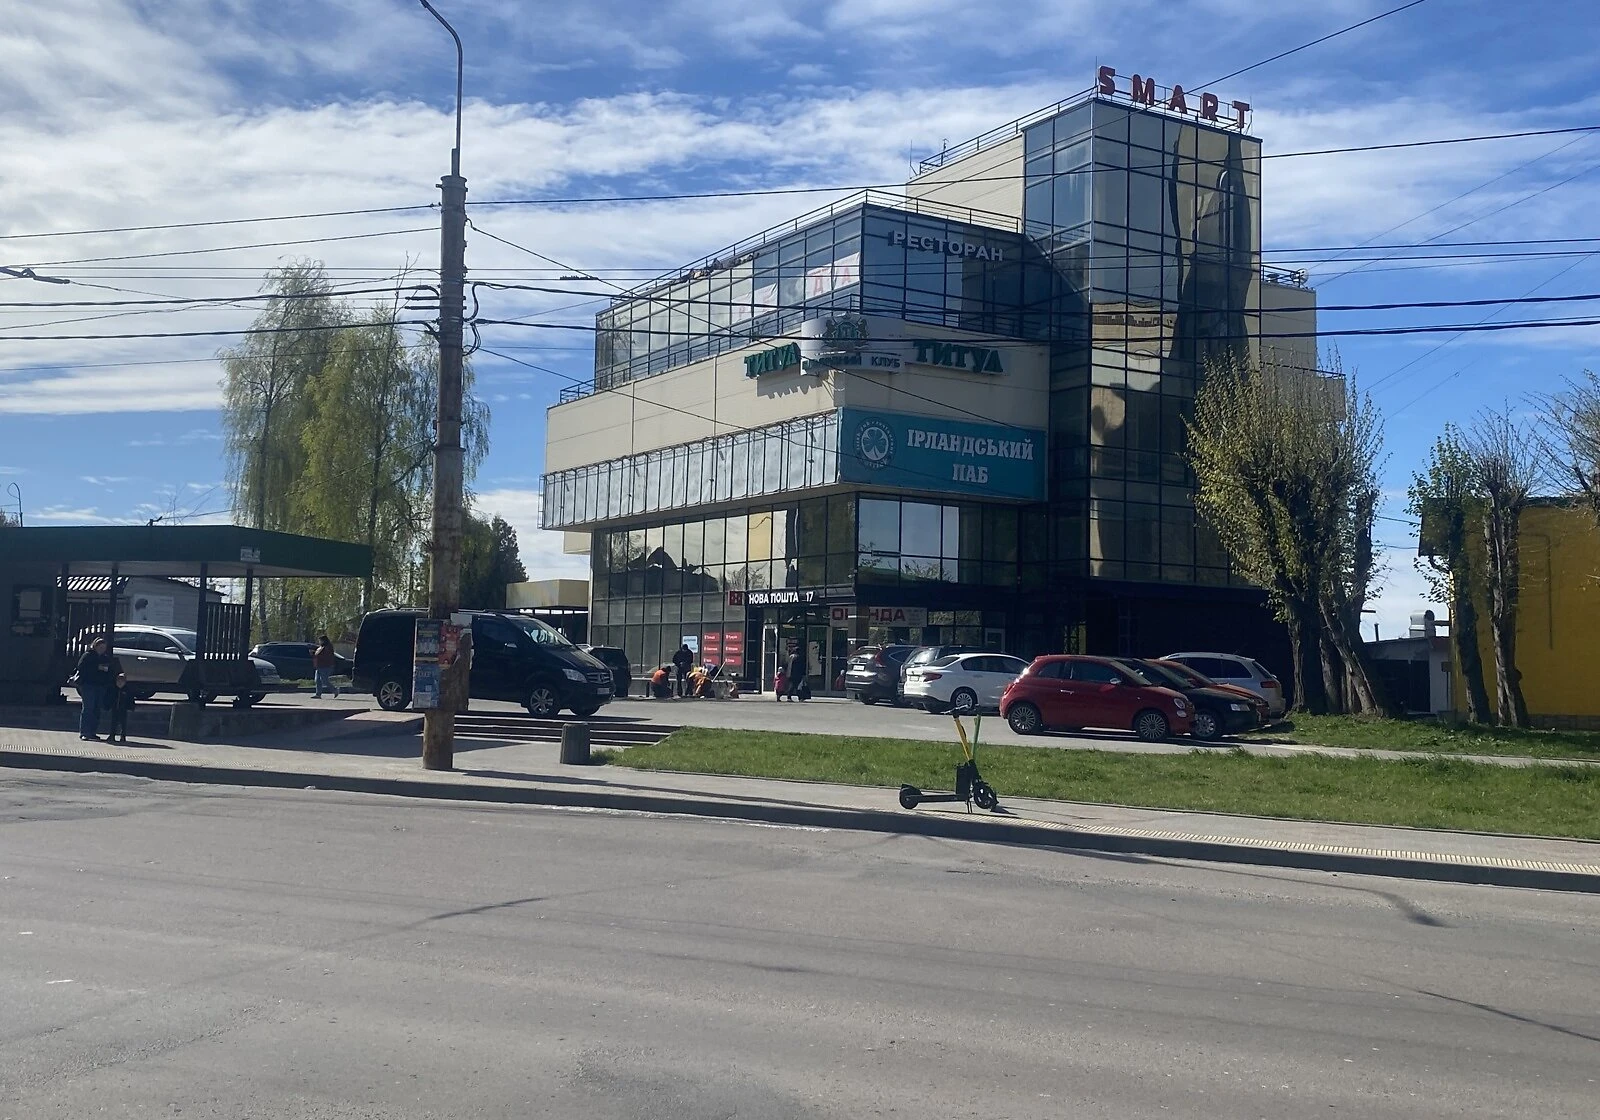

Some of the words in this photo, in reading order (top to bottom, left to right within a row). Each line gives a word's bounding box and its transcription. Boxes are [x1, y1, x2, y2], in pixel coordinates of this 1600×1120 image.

[1098, 65, 1250, 129] SMART
[891, 230, 1003, 262] РЕСТОРАН
[744, 342, 801, 379] ТИТУЛ
[871, 355, 900, 368] КЛУБ
[913, 340, 1004, 373] ТИТУЛ
[907, 429, 1034, 460] ІРЛАНДСЬКИЙ
[952, 463, 989, 483] ПАБ
[748, 593, 769, 605] НОВА
[770, 591, 799, 604] ПОШТА
[805, 591, 814, 602] 17
[832, 608, 906, 622] ОНДА
